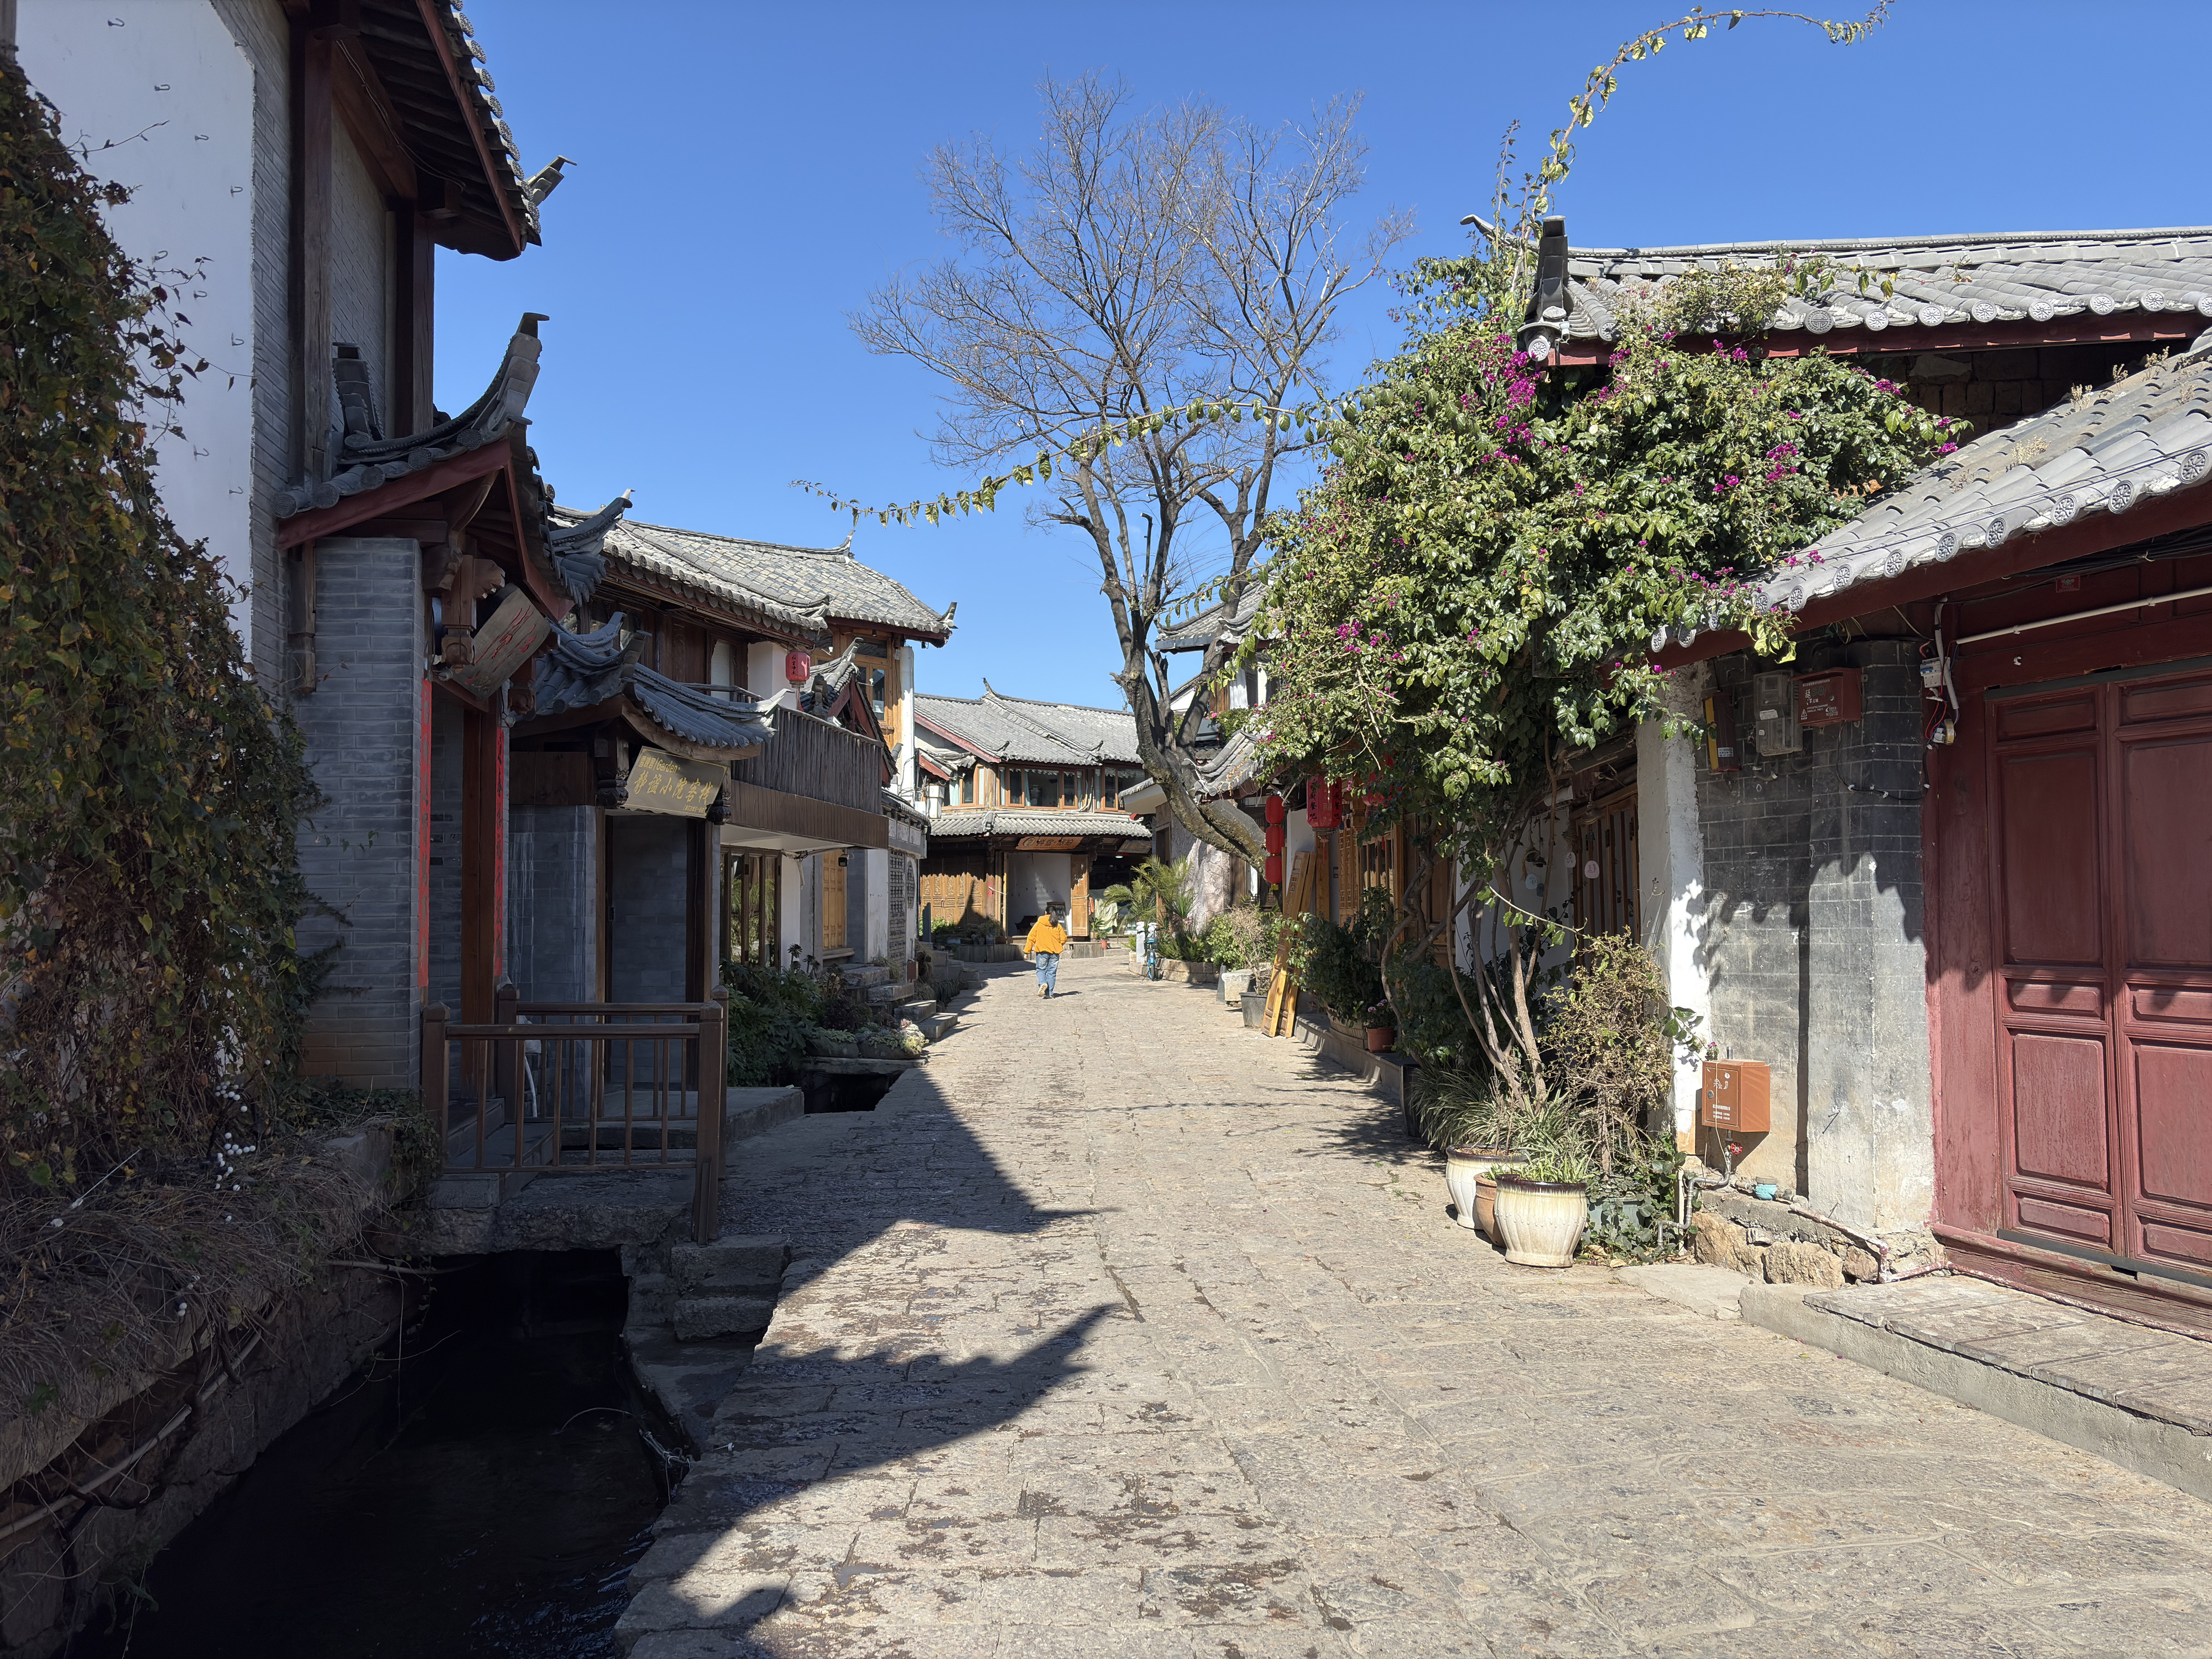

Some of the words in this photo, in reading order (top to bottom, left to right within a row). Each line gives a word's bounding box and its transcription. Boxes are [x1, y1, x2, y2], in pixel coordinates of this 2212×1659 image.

[634, 770, 713, 805] 静谧小院客栈
